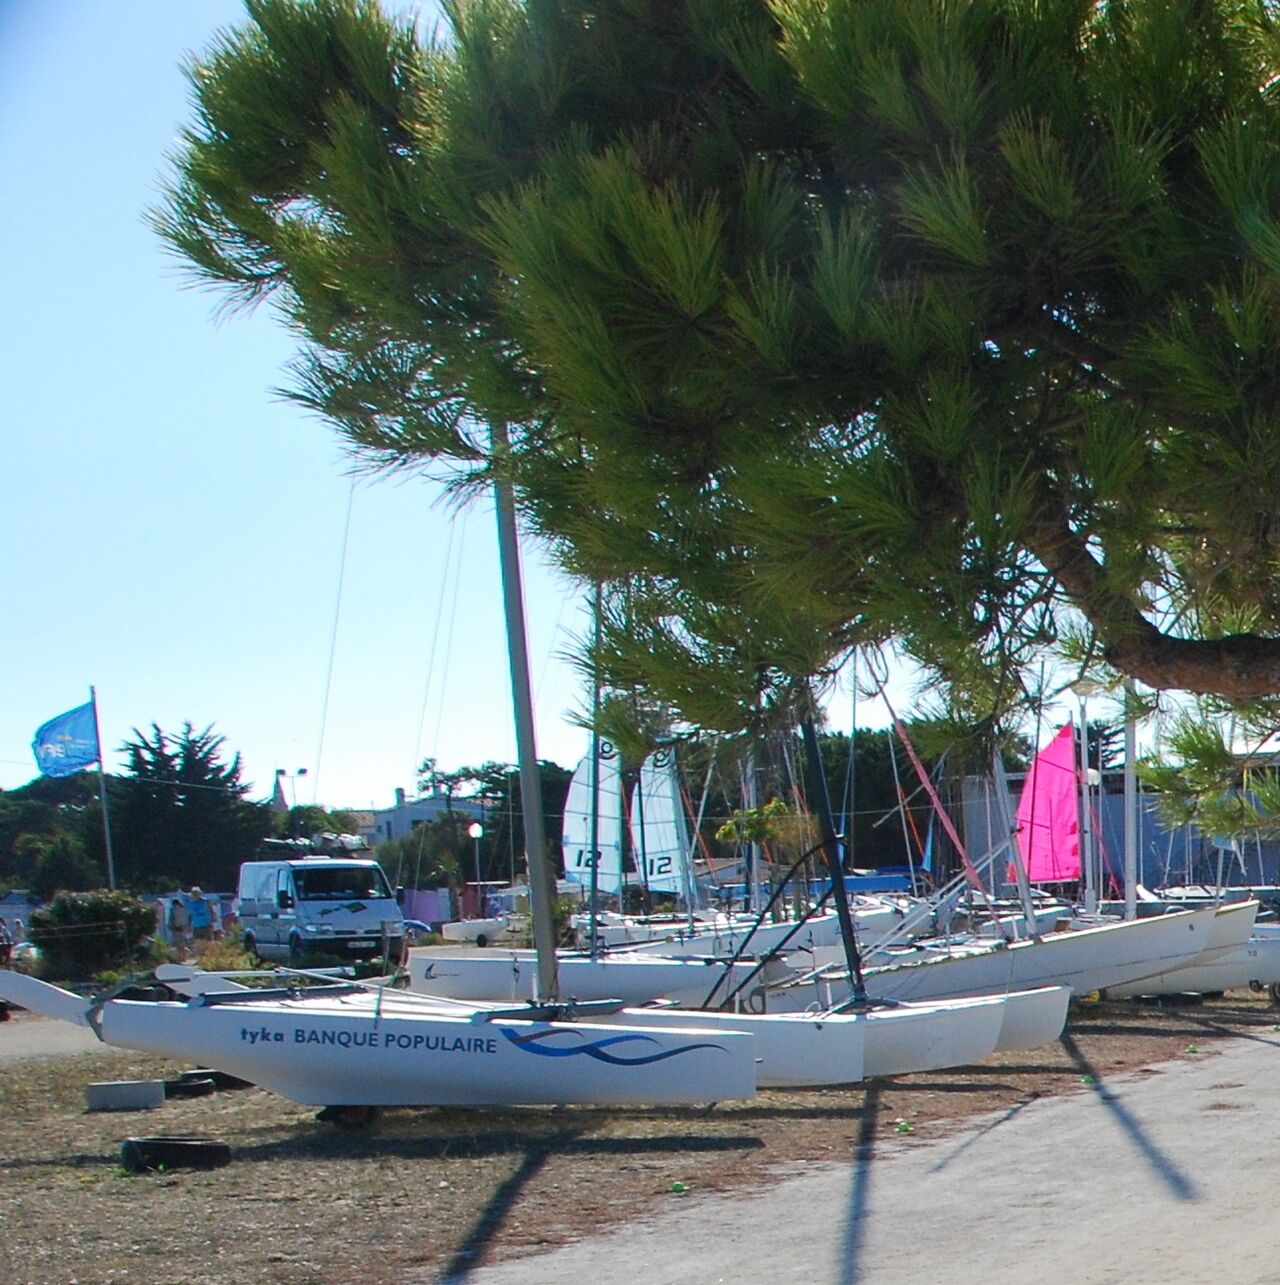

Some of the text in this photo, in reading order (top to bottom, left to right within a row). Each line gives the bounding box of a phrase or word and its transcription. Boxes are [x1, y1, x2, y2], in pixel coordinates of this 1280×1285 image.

[649, 856, 672, 876] 12
[241, 1027, 497, 1053] tyka BANQUE POPULAIRE
